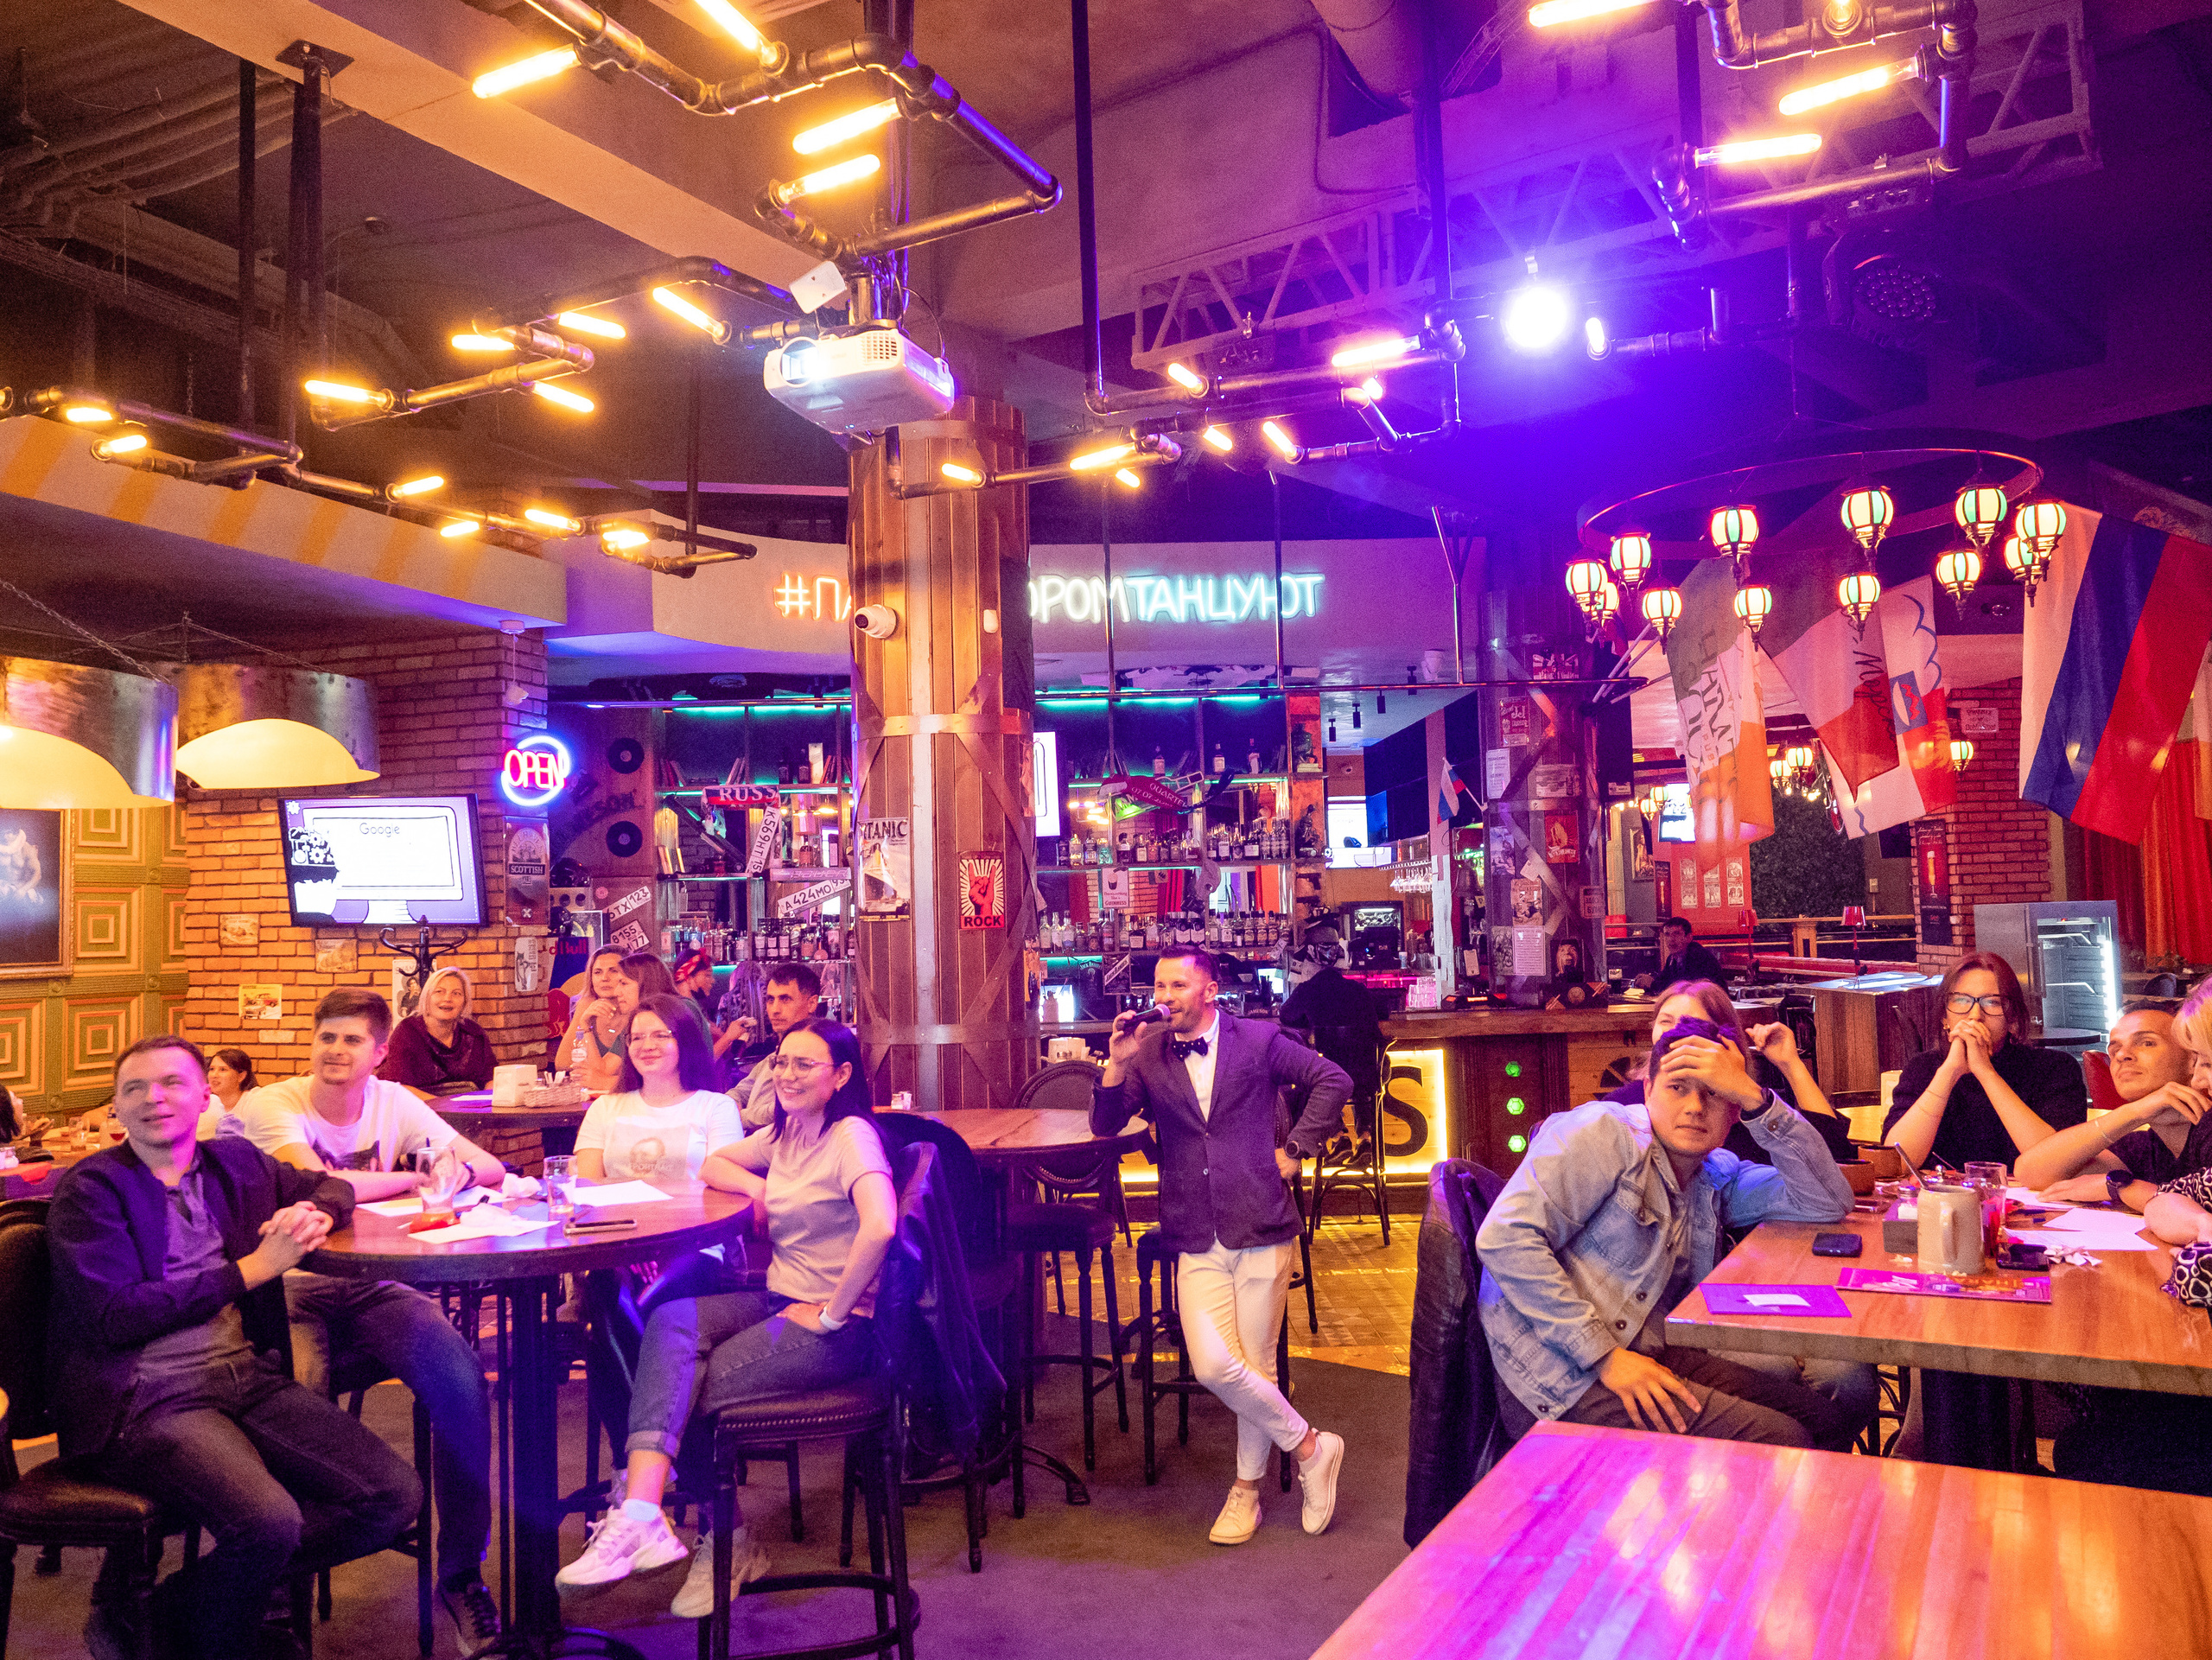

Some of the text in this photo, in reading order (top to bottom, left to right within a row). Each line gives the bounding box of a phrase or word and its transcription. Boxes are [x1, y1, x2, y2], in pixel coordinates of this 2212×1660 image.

[504, 748, 566, 788] OPEN
[359, 822, 400, 838] Google
[510, 865, 543, 875] SCOTTISH
[963, 916, 1002, 926] ROCK
